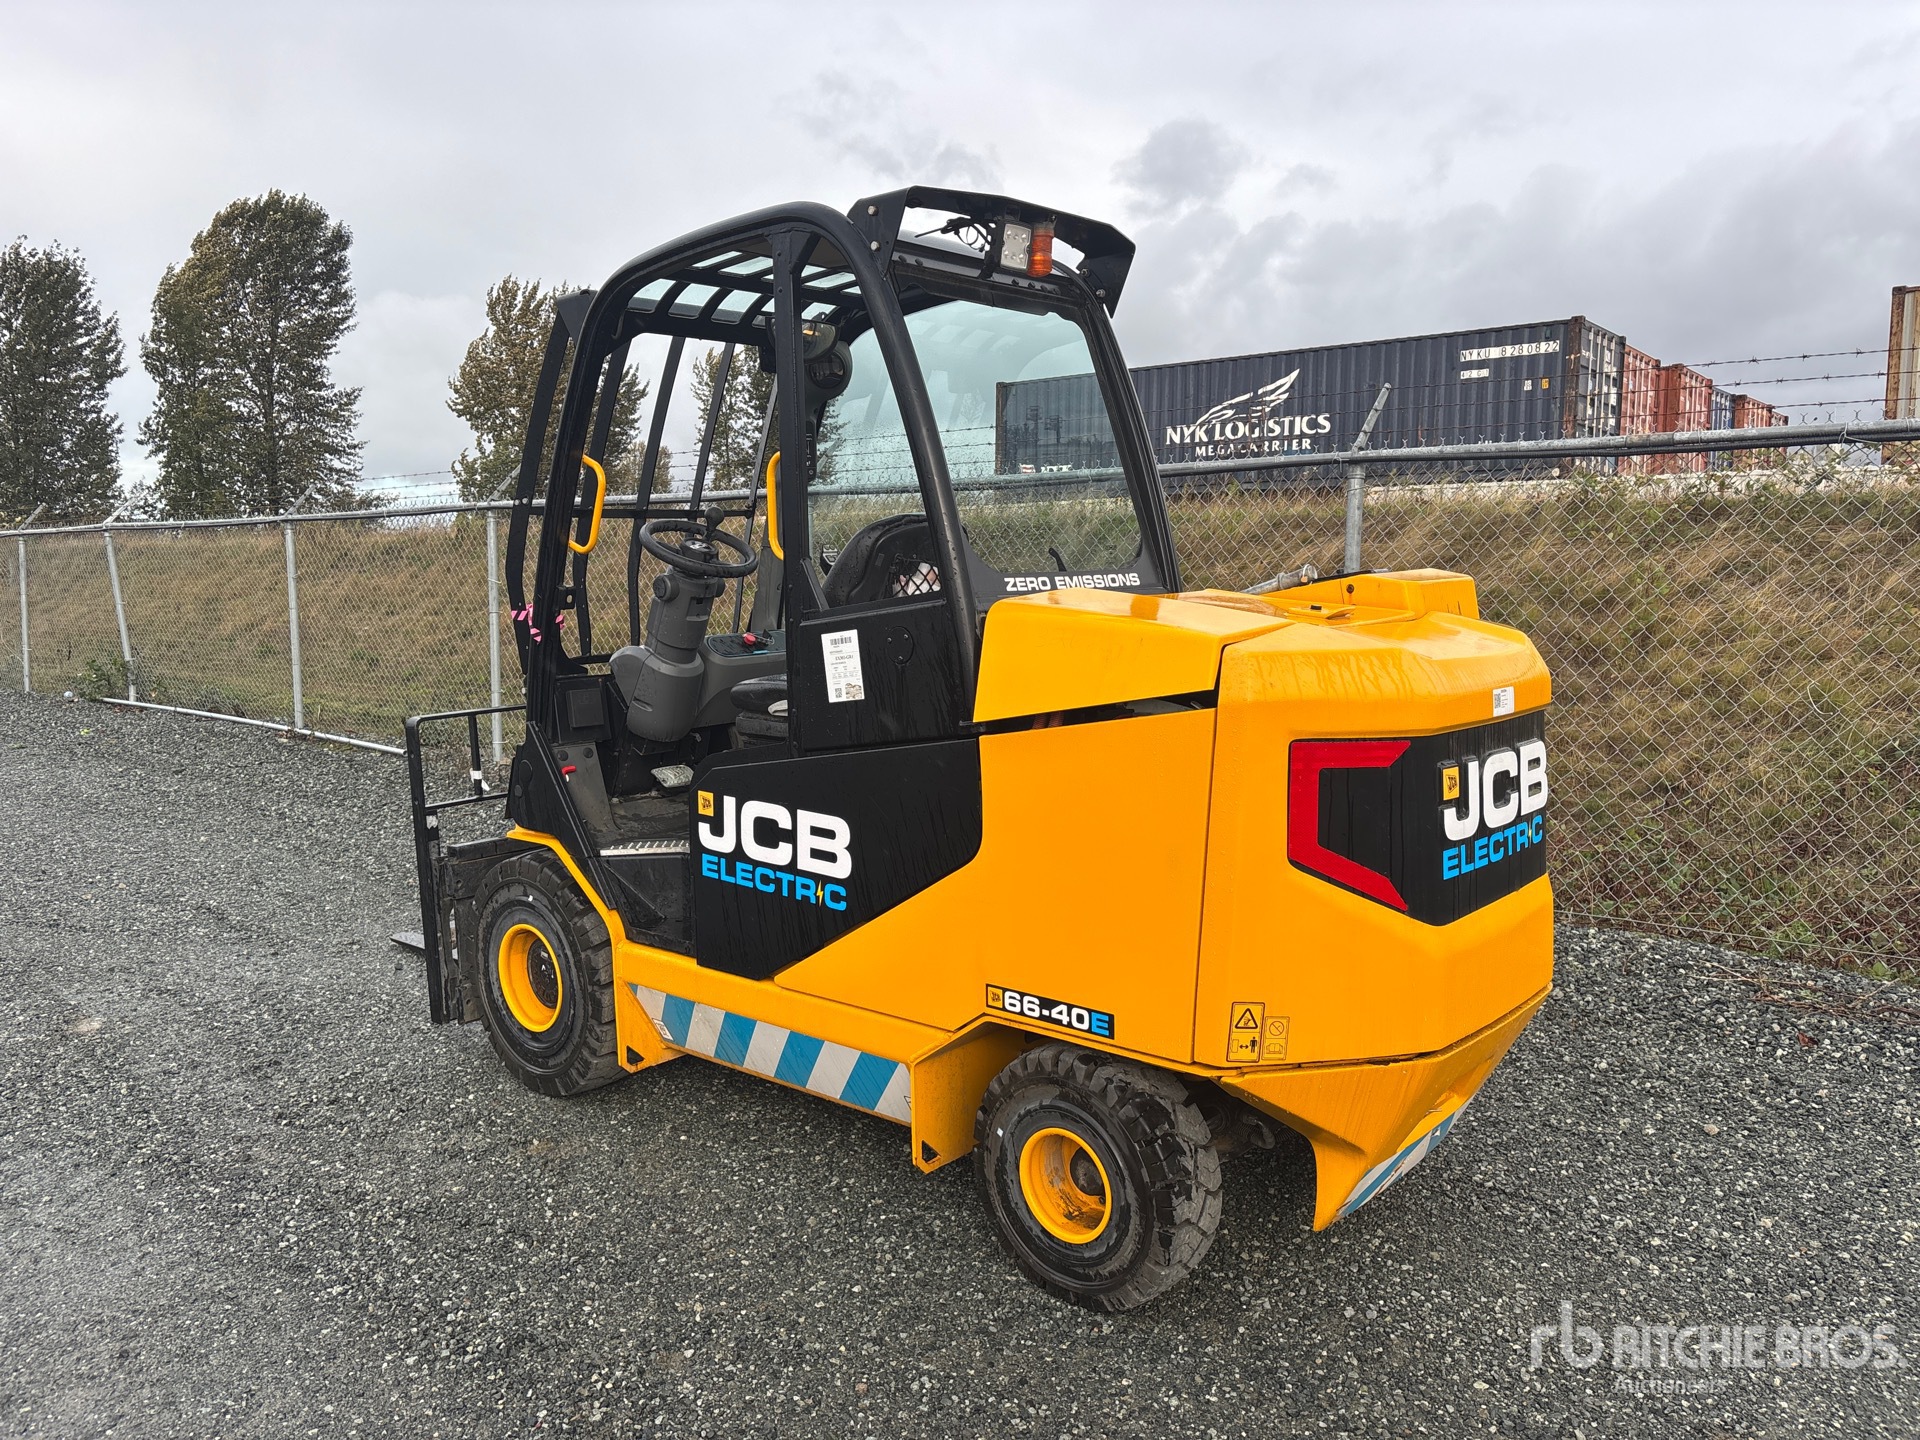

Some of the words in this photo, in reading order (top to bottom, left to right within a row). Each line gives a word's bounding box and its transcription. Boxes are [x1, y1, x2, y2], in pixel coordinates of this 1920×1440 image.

[1461, 349, 1491, 360] NYKU
[1165, 424, 1212, 445] NYK
[1214, 413, 1332, 441] LOGISTICS
[1004, 576, 1051, 592] ZERO
[1054, 572, 1141, 590] EMISSIONS
[1443, 740, 1549, 841] JCB
[698, 795, 852, 879] JCB
[1442, 814, 1543, 880] ELECTRIC
[702, 853, 847, 911] ELECTRIC
[1004, 990, 1109, 1036] 66-40E
